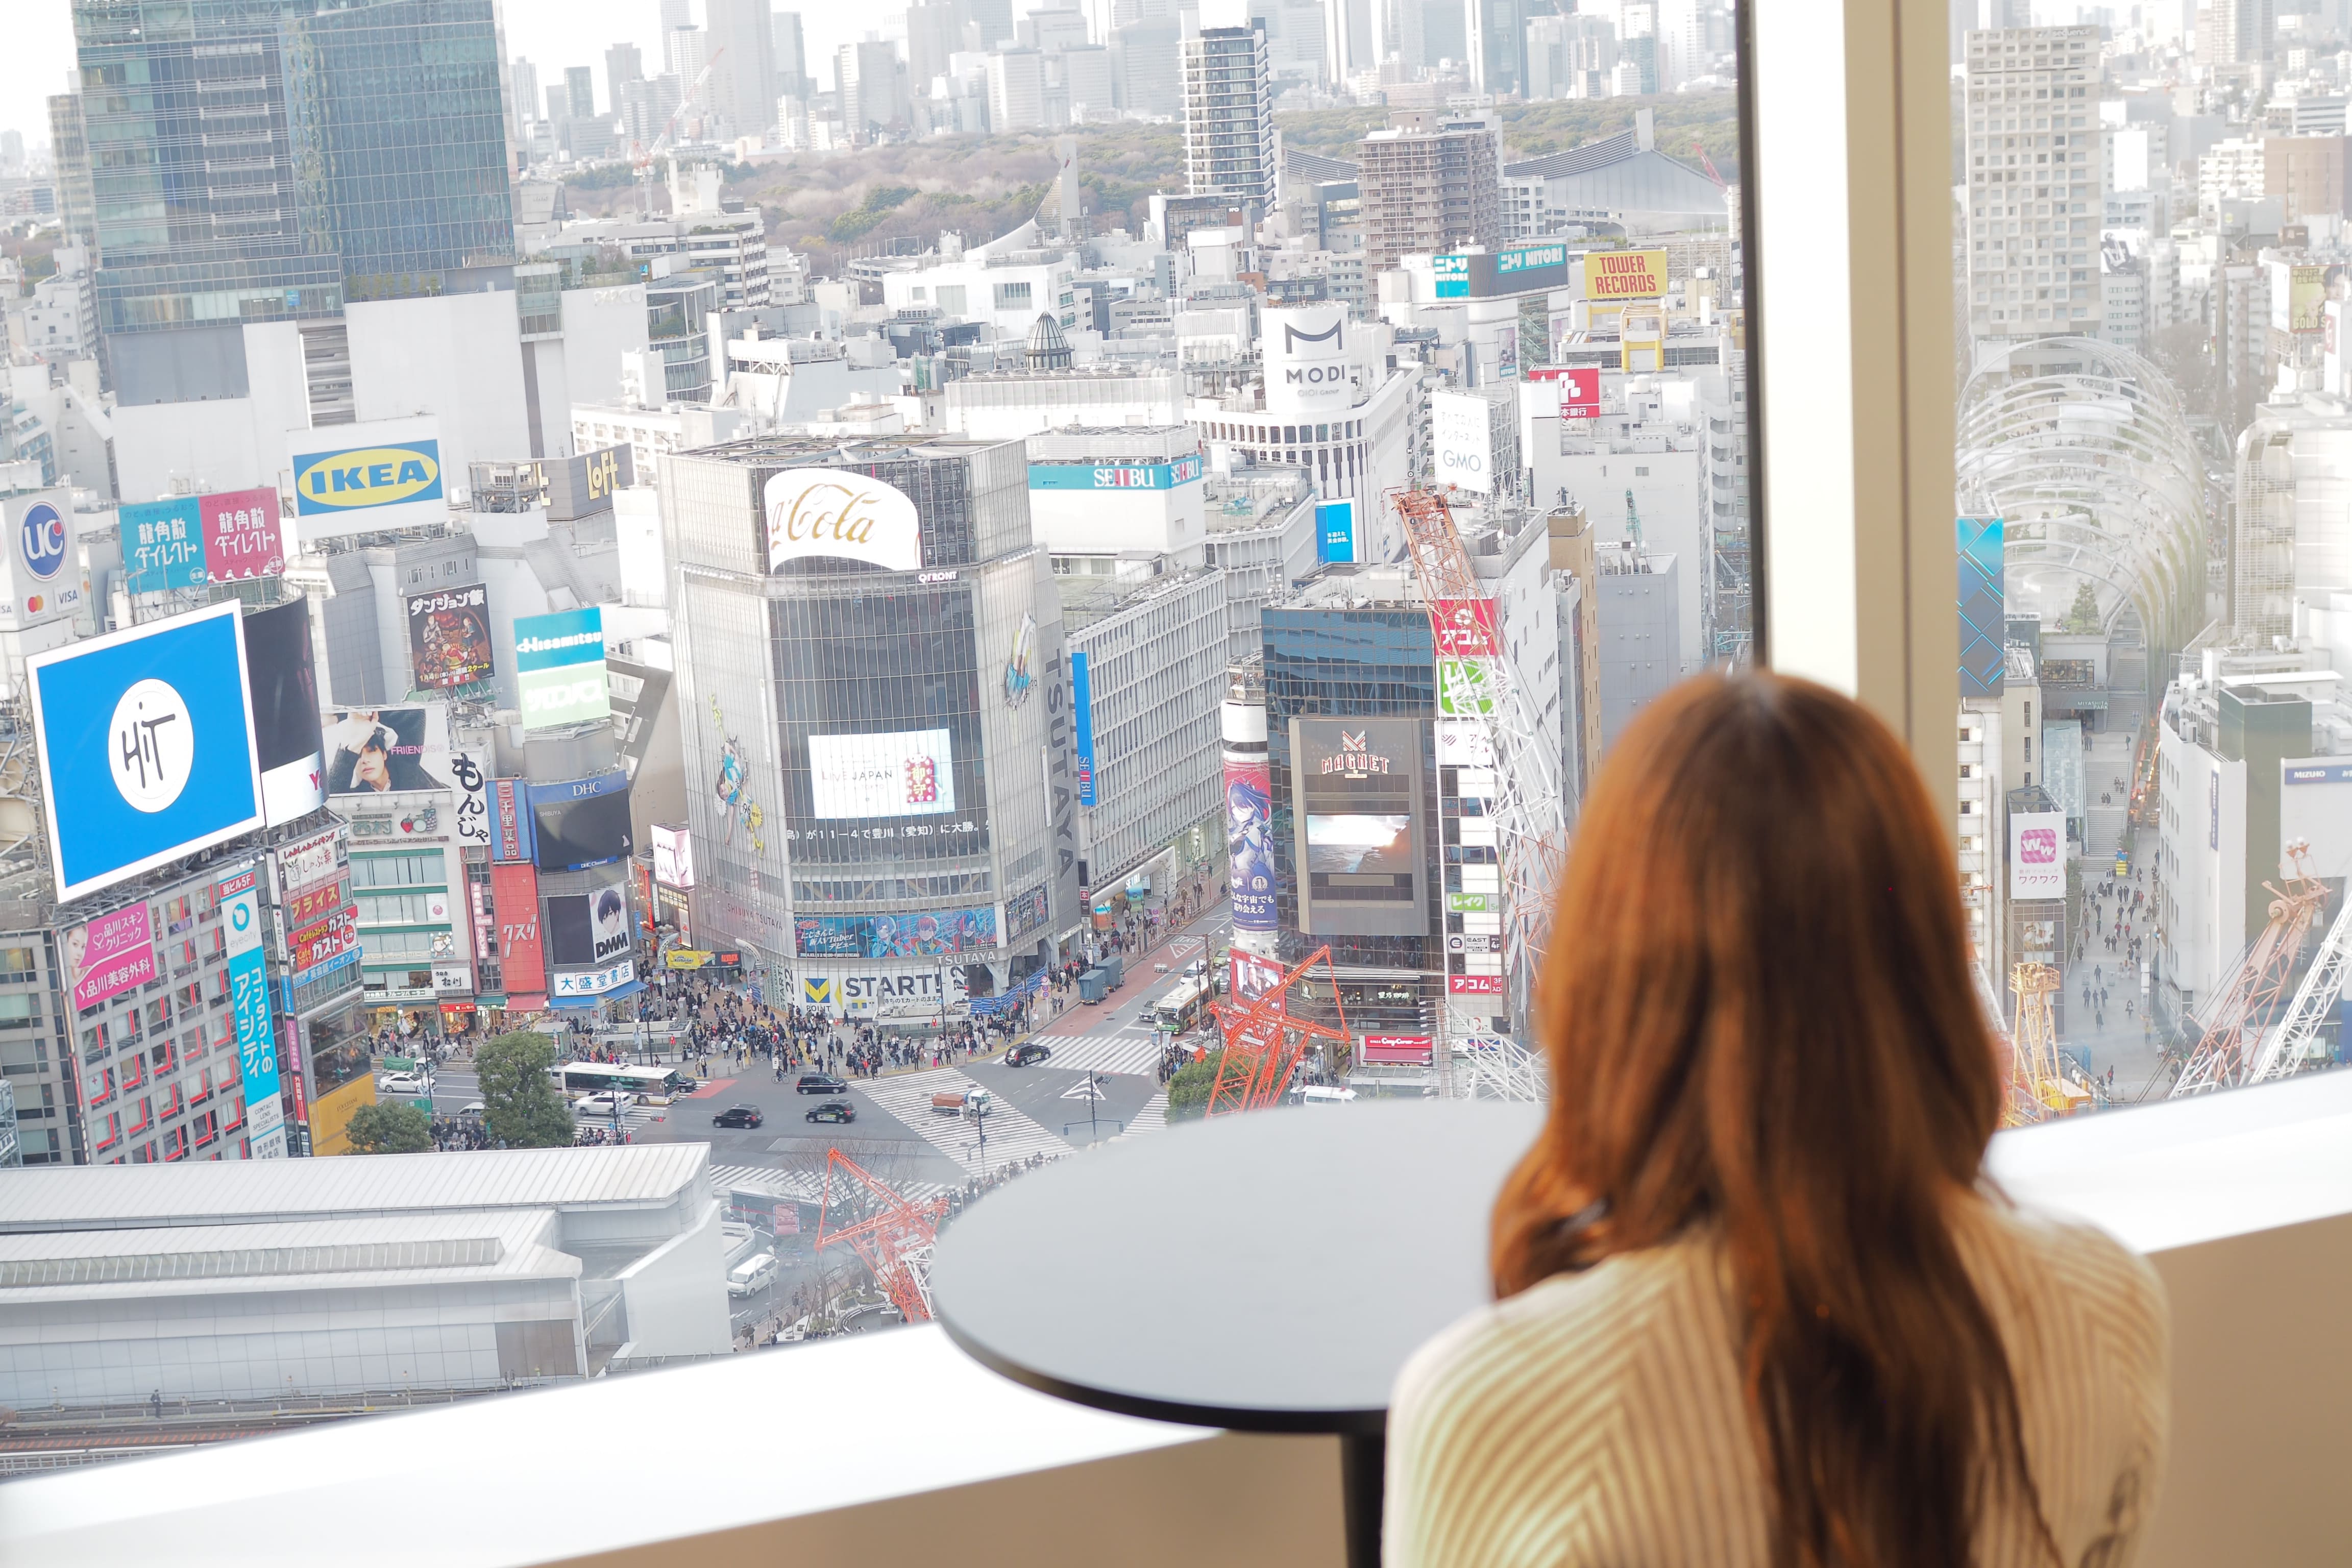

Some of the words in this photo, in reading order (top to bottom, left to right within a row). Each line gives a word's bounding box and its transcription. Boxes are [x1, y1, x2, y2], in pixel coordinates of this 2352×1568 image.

[1435, 258, 1467, 273] ニトリ
[1500, 253, 1522, 271] ニトリ
[1526, 246, 1563, 266] NITORI
[1599, 255, 1646, 275] TOWER
[1435, 273, 1468, 282] NITORI
[1595, 274, 1656, 295] RECORDS
[594, 288, 644, 306] PARCO
[1286, 364, 1345, 384] MODI
[1561, 407, 1587, 416] 本銀行
[1443, 450, 1481, 472] GMO
[311, 459, 429, 494] IKEA
[138, 516, 187, 545] 龍角散
[218, 506, 265, 534] 龍角散
[24, 519, 63, 560] UC
[214, 530, 276, 558] ダイレクト
[59, 590, 78, 604] VISA
[1045, 648, 1074, 879] TSUTAYA
[1321, 753, 1389, 774] MAGNET
[852, 769, 893, 781] JAPAN
[452, 753, 488, 843] もんじゃ
[572, 781, 601, 796] DHC
[222, 874, 252, 896] 当ビル5F
[2019, 875, 2058, 885] ワクワク
[1453, 895, 1483, 906] レイク
[312, 936, 340, 960] ガスト
[596, 933, 628, 958] DMM
[937, 951, 996, 966] TSUTAYA
[86, 957, 151, 999] 品川美容外科
[561, 964, 630, 989] 大盛堂書店
[846, 974, 941, 997] START!
[1455, 979, 1489, 990] アコム
[234, 973, 260, 1077] アイシティ
[251, 967, 272, 1072] コンタクトの
[255, 1101, 274, 1115] CONTACT
[259, 1110, 271, 1120] LENS
[253, 1113, 279, 1130] SPECIALISTS
